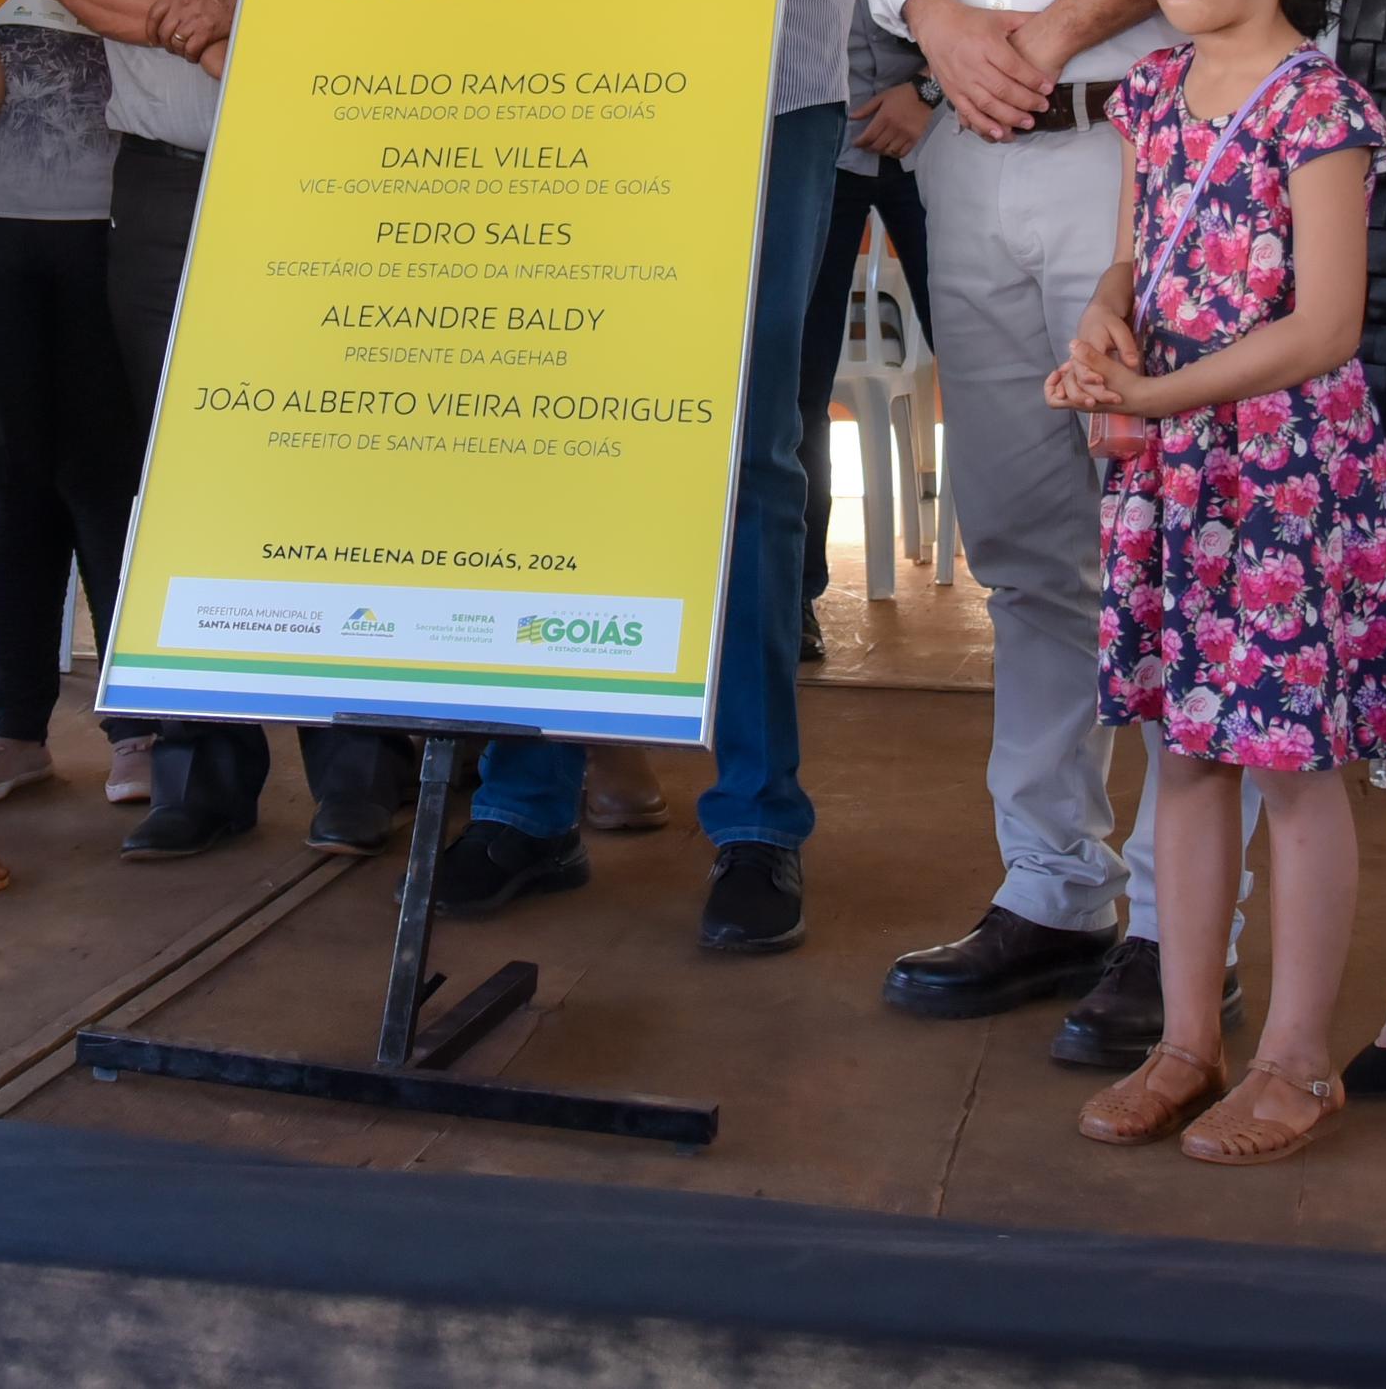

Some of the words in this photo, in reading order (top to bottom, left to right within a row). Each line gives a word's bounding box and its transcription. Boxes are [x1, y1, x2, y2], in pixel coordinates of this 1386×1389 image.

[312, 74, 451, 95] RONALDO
[462, 73, 565, 94] RAMOS
[576, 72, 686, 94] CAIADO
[333, 106, 458, 121] GOVERNADOR
[464, 106, 490, 121] DO
[495, 105, 565, 120] ESTADO
[572, 105, 595, 120] DE
[601, 101, 655, 120] GOIÁS
[382, 147, 483, 168] DANIEL
[495, 147, 588, 168] VILELA
[300, 179, 469, 195] VICE-GOVERNADOR
[476, 179, 502, 195] DO
[509, 179, 579, 195] ESTADO
[586, 180, 609, 195] DE
[614, 176, 670, 195] GOIÁS
[377, 222, 475, 244] PEDRO
[485, 223, 571, 245] SALES
[266, 258, 373, 277] SECRETÁRIO
[378, 263, 402, 277] DE
[407, 262, 478, 279] ESTADO
[484, 264, 508, 278] DA
[515, 264, 677, 281] INFRAESTRUTURA
[321, 305, 497, 329] ALEXANDRE
[508, 308, 604, 331] BALDY
[345, 347, 455, 363] PRESIDENTE
[460, 349, 485, 364] DA
[490, 350, 567, 367] AGEHAB
[194, 382, 274, 411] JOÃO
[282, 390, 416, 415] ALBERTO
[427, 393, 520, 418] VIEIRA
[533, 396, 712, 423] RODRIGUES
[268, 432, 351, 449] PREFEITO
[357, 434, 381, 450] DE
[387, 435, 446, 451] SANTA
[453, 437, 526, 454] HELENA
[533, 439, 557, 455] DE
[564, 437, 621, 457] GOIÁS
[262, 544, 327, 560] SANTA
[335, 547, 414, 564] HELENA
[421, 550, 447, 565] DE
[454, 548, 521, 571] GOIÁS,
[528, 555, 577, 571] 2024
[196, 606, 254, 618] PREFEITURA
[255, 609, 308, 620] MUNICIPAL
[309, 611, 324, 621] DE
[451, 614, 496, 624] SEINFRA
[198, 620, 231, 630] SANTA
[232, 622, 273, 632] HELENA
[273, 624, 289, 633] DE
[290, 622, 322, 634] GOIÁS
[342, 621, 396, 633] AGEHAB
[413, 623, 454, 633] Secretaria
[453, 625, 467, 635] de
[465, 624, 494, 635] Estado
[541, 616, 643, 647] GOIÁS
[428, 634, 441, 642] da
[440, 633, 494, 644] Infraestrutura
